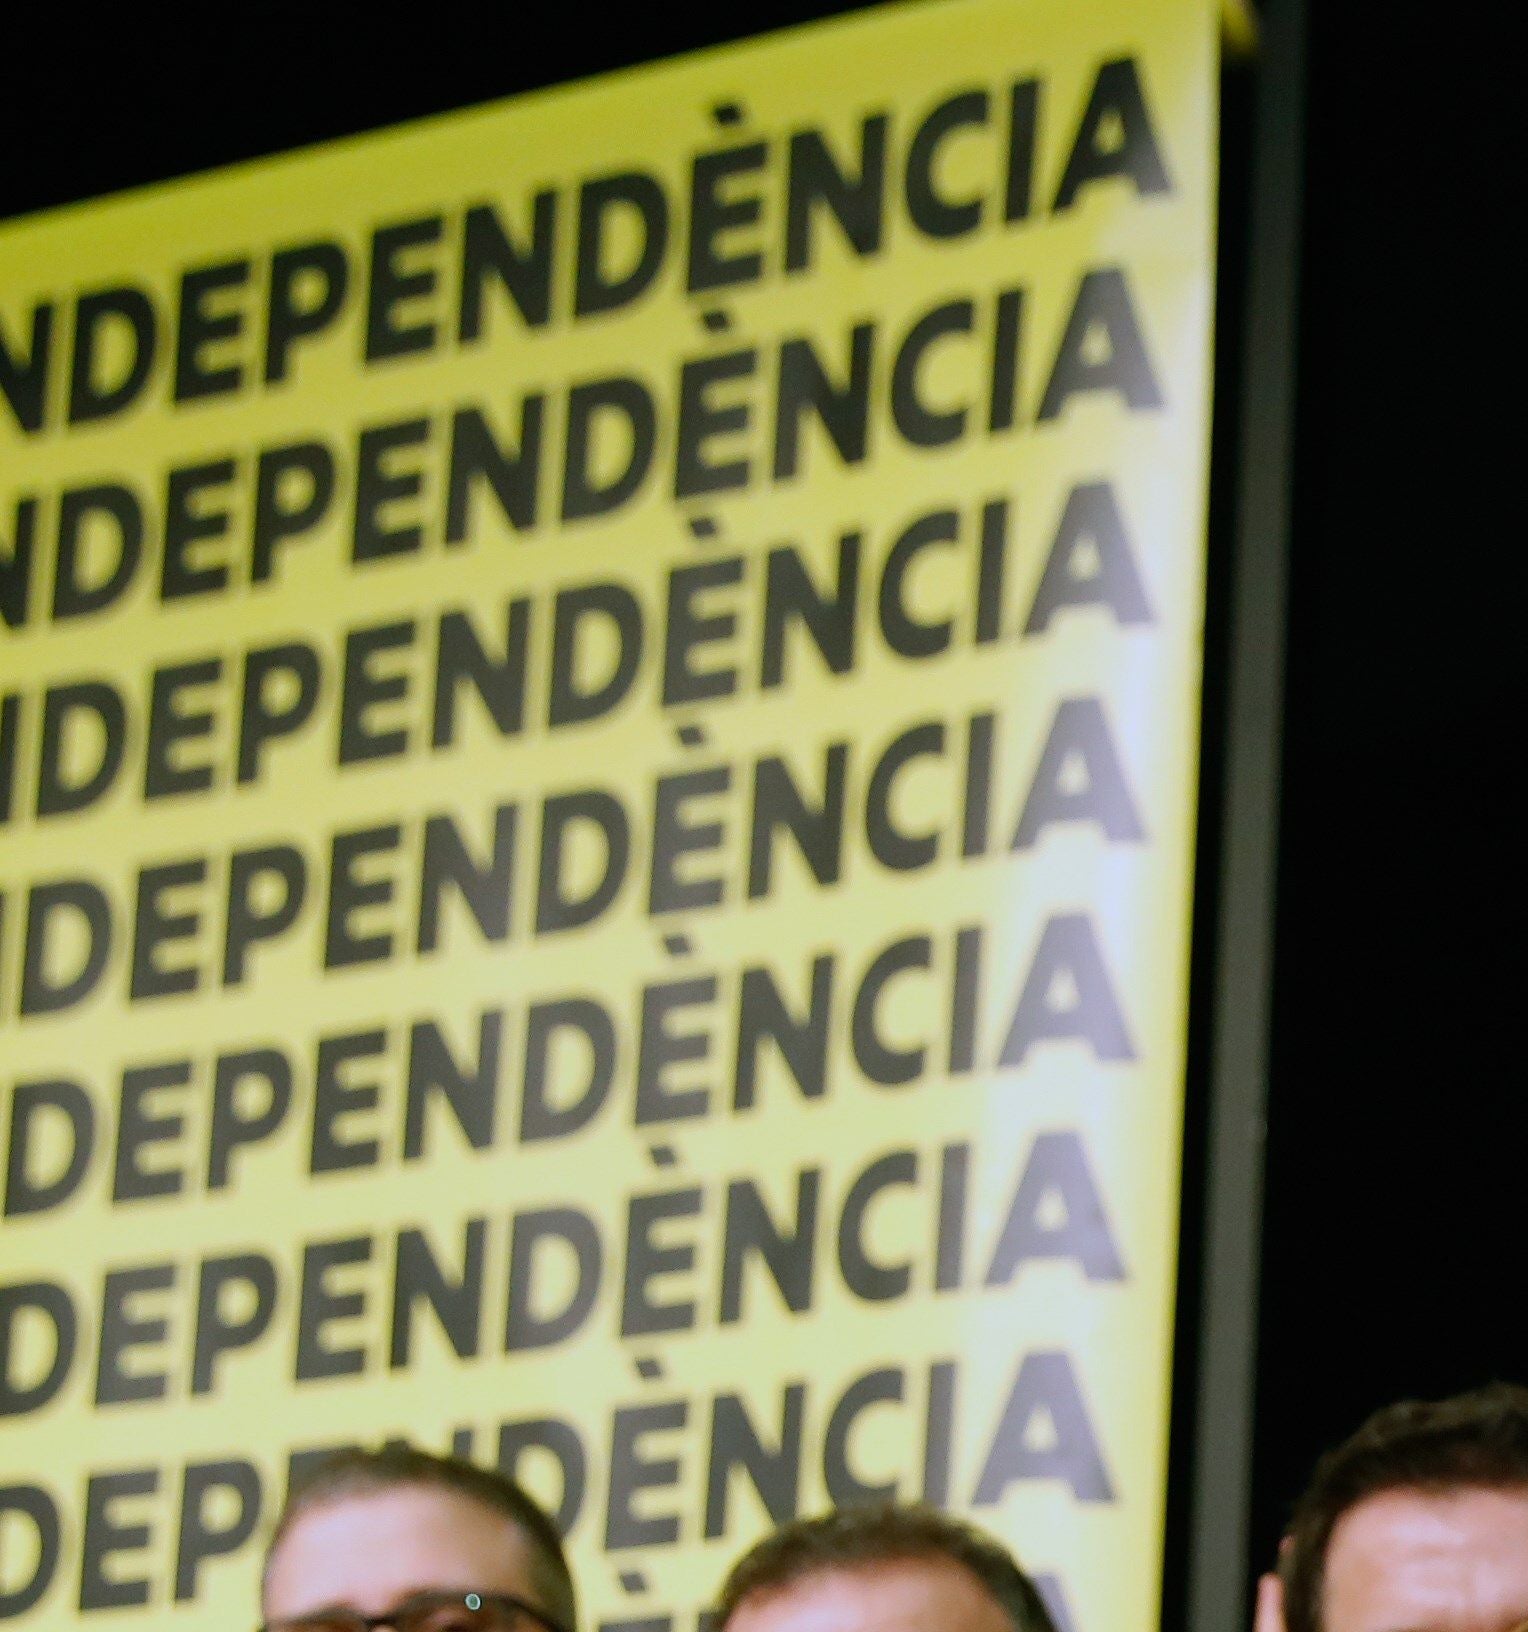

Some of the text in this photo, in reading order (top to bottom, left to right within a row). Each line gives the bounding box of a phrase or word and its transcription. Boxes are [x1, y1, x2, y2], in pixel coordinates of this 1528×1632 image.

[0, 478, 1158, 822] DEPENDÈNCIA
[0, 695, 1149, 1018] DEPENDÈNCIA
[3, 910, 1140, 1220] DEPENDÈNCIA
[0, 1130, 1129, 1418] DEPENDÈNCIA
